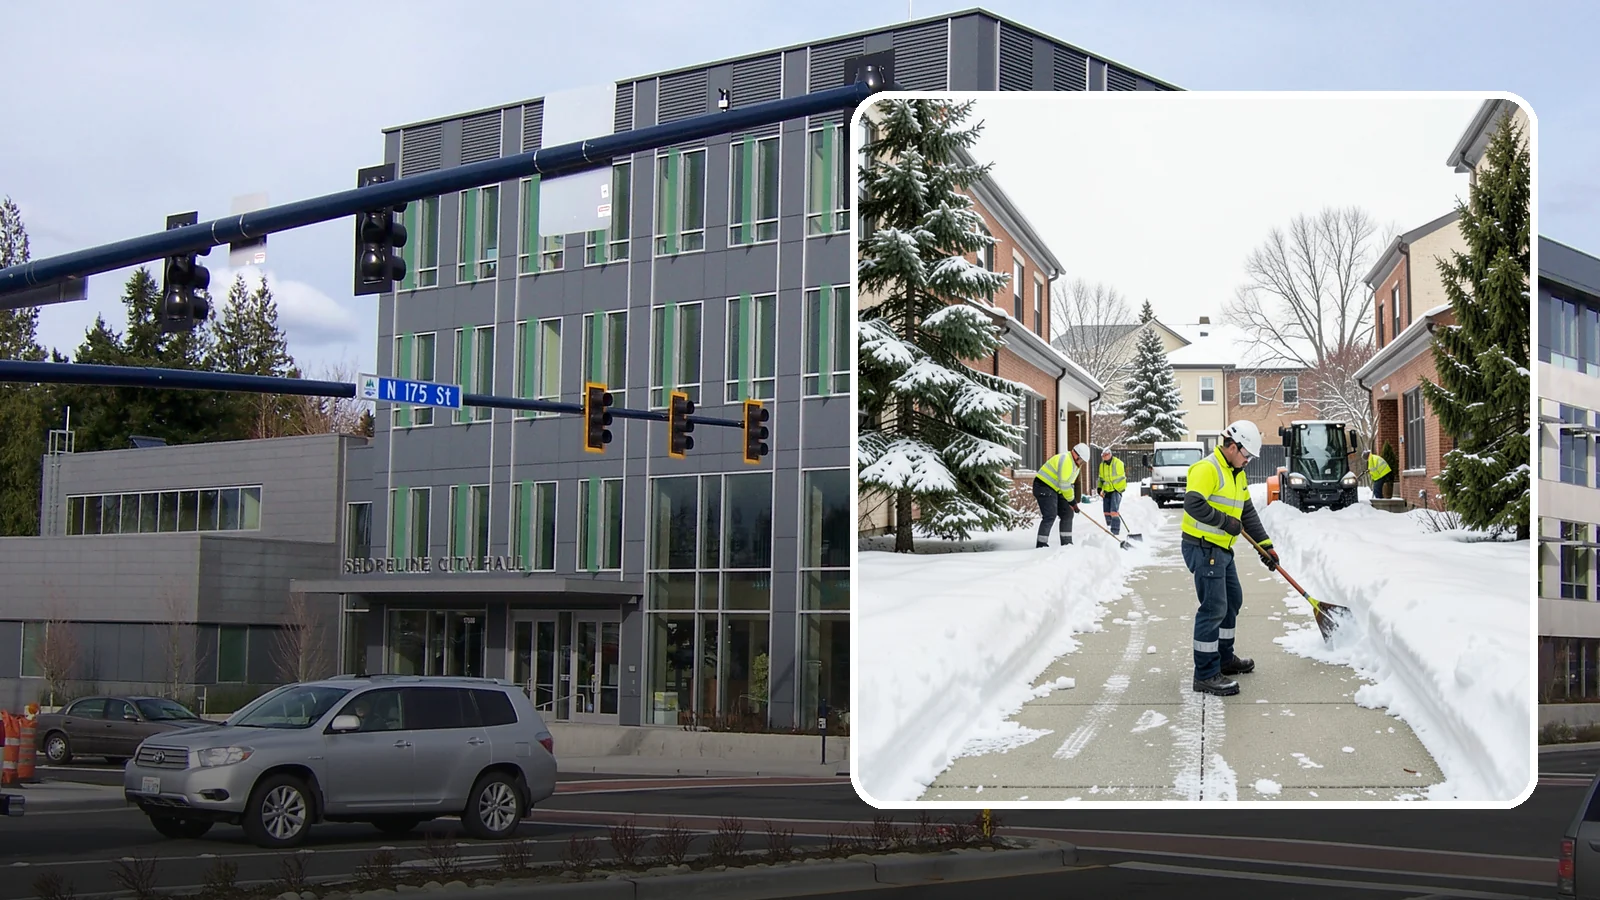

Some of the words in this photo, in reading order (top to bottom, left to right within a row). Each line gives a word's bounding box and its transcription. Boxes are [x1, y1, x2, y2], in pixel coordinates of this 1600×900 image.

[387, 380, 396, 400] N
[405, 382, 427, 403] 175
[436, 386, 451, 406] St
[345, 557, 432, 573] SHORELINE
[438, 557, 476, 572] CITY
[484, 556, 525, 572] HALL
